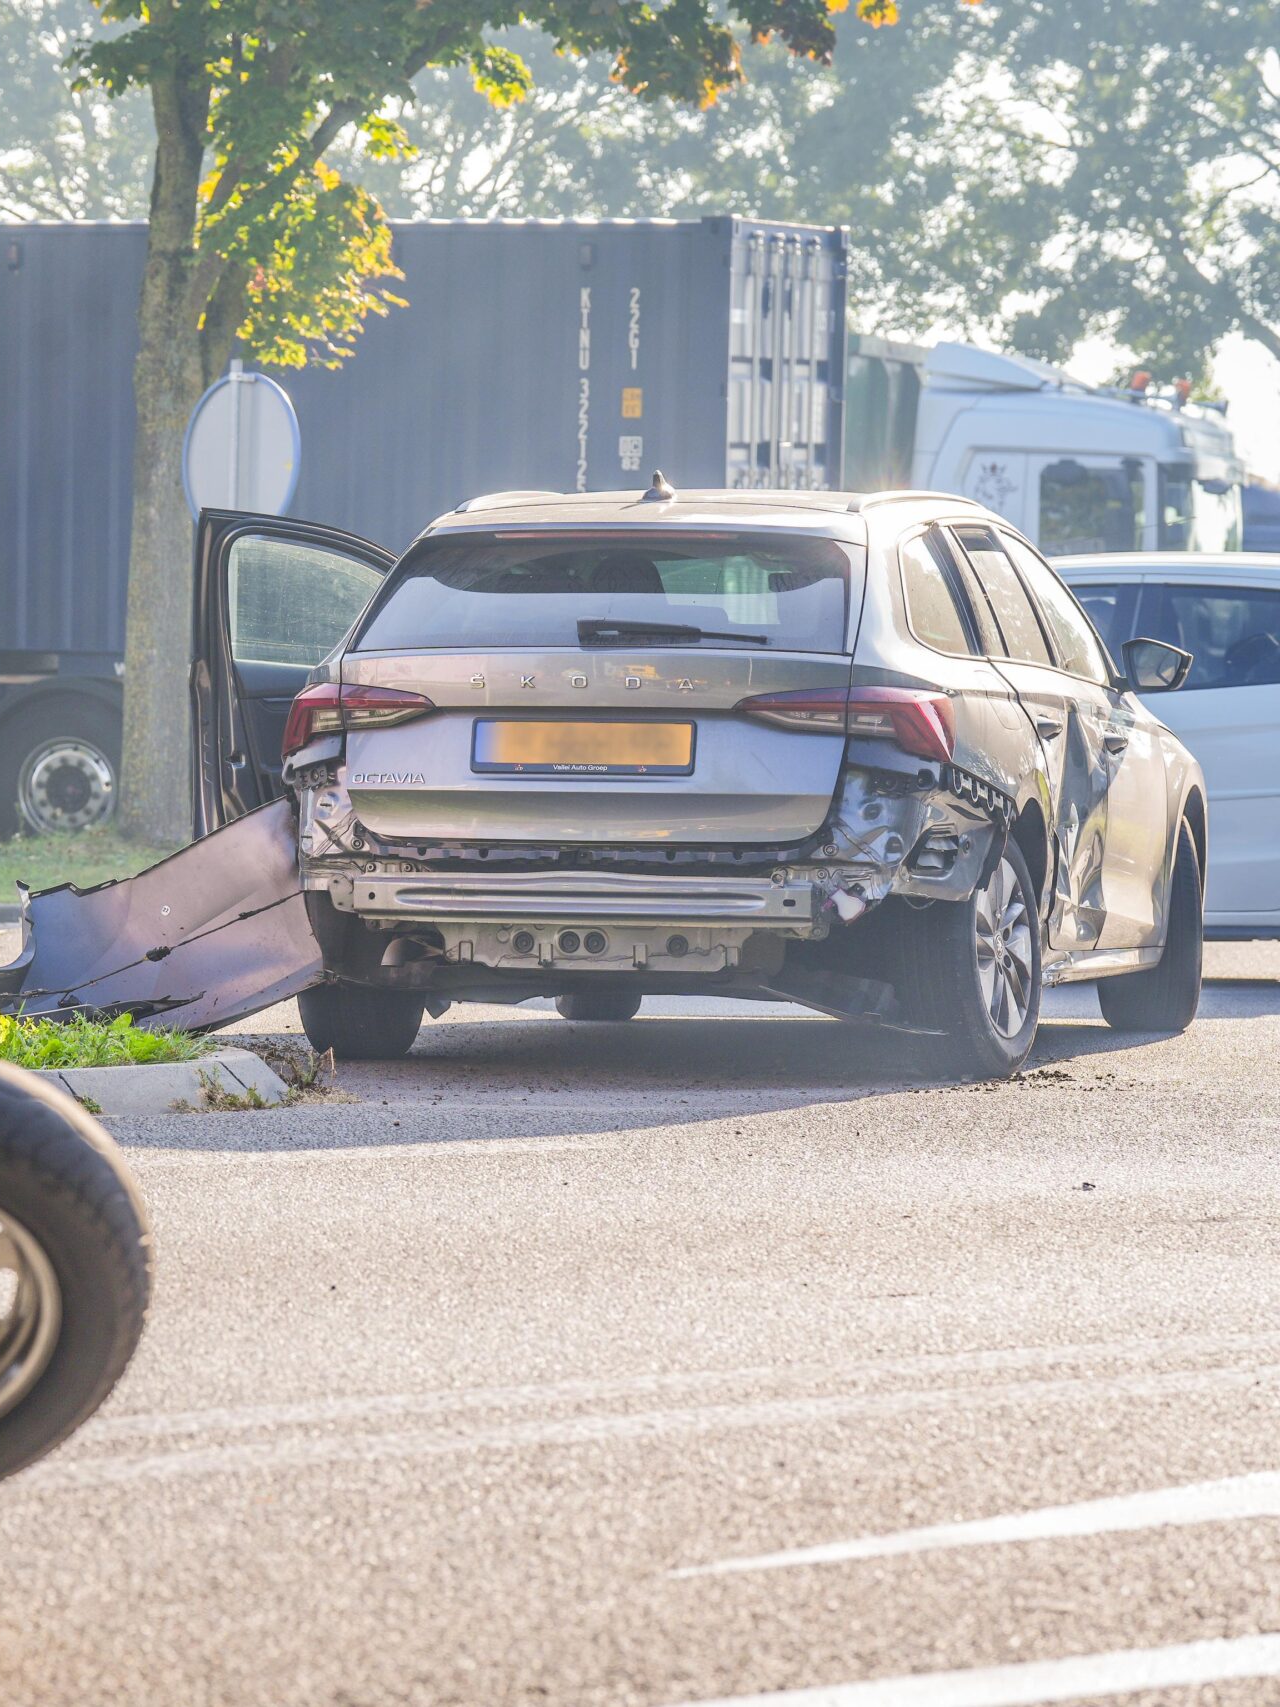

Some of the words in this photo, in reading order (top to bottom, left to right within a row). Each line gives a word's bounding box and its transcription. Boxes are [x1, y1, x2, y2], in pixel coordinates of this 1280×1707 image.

[579, 287, 591, 370] KTNU
[628, 287, 640, 370] 22G1
[351, 773, 426, 784] OCTAVIA
[588, 764, 608, 772] Groep
